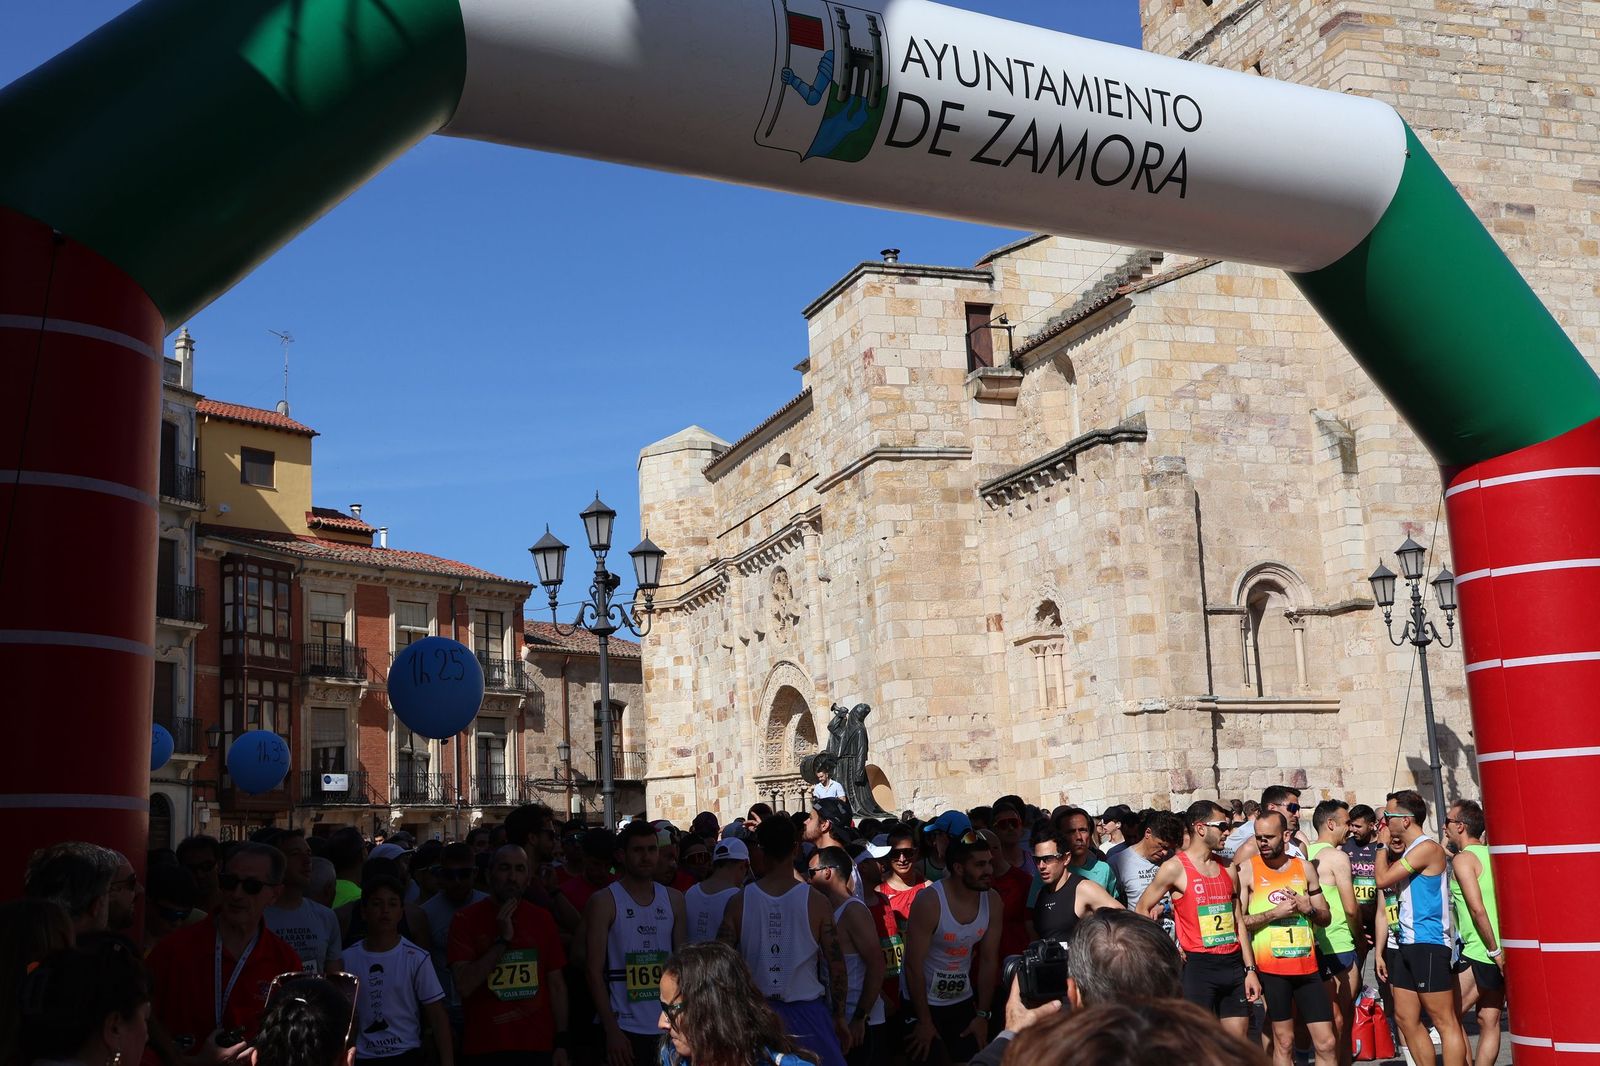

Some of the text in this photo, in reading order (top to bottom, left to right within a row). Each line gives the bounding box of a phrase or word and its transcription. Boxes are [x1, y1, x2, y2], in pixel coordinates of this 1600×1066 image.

[901, 35, 1203, 133] AYUNTAMIENTO
[884, 91, 1187, 199] DE ZAMORA
[1355, 886, 1377, 898] 216
[1213, 915, 1224, 931] 2
[1286, 928, 1294, 944] 1
[491, 964, 530, 986] 275
